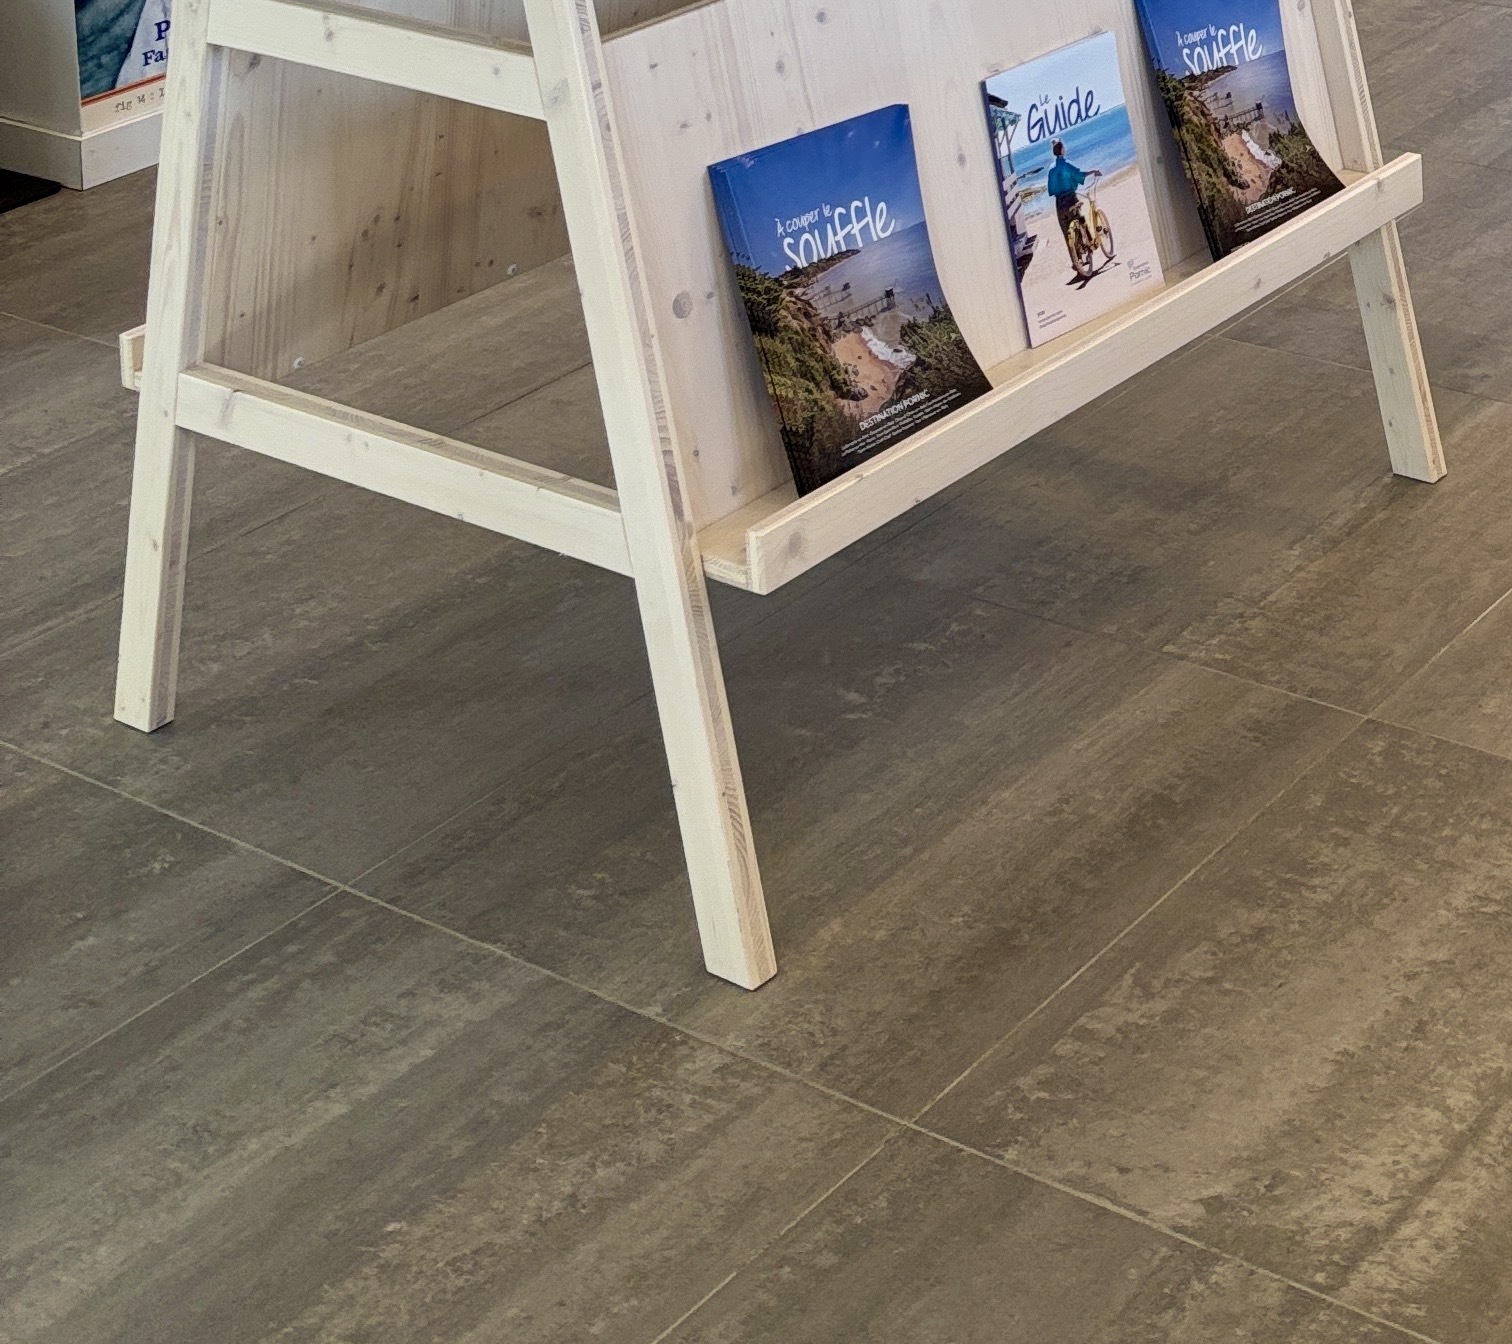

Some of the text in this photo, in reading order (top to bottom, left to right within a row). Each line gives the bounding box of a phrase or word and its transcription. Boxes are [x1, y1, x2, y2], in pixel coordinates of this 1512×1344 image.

[1183, 22, 1263, 77] souffle
[1027, 85, 1101, 144] Guide
[783, 195, 896, 272] souffle
[785, 207, 820, 233] couper
[821, 203, 833, 217] le
[859, 402, 903, 431] DESTINATION
